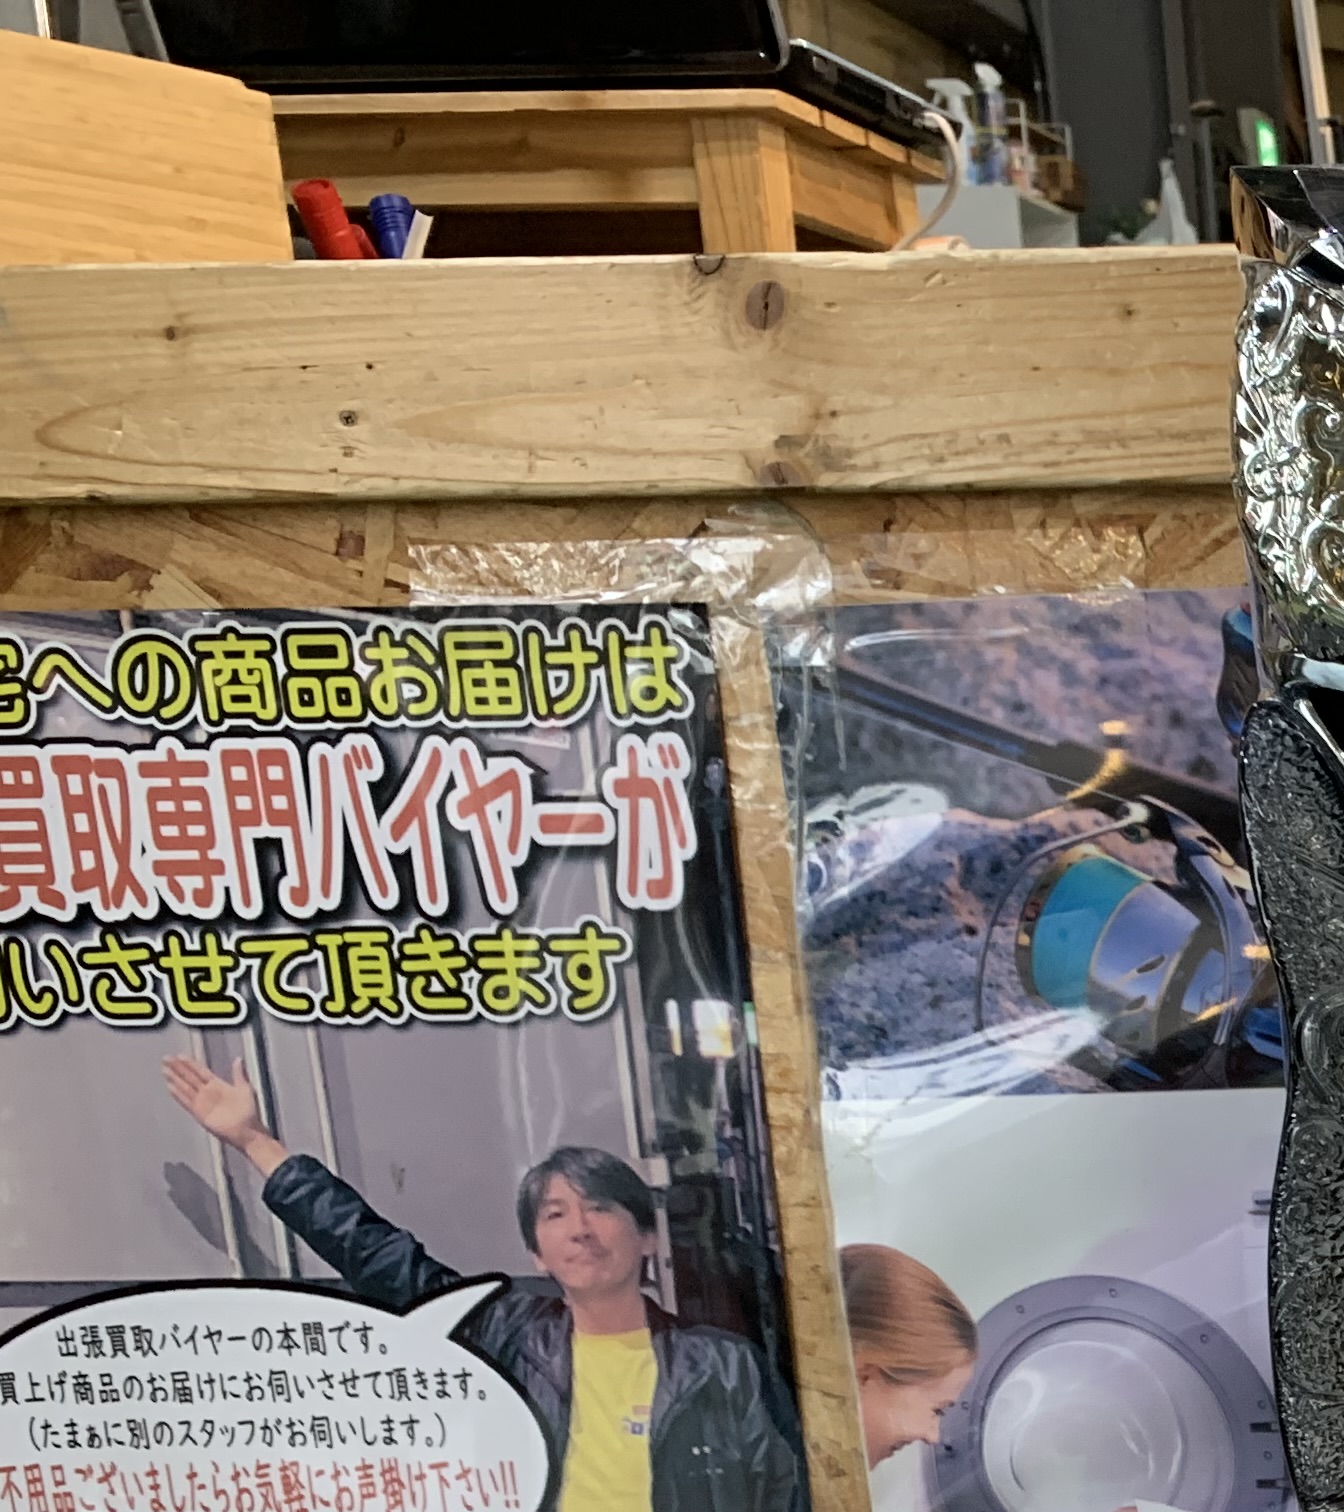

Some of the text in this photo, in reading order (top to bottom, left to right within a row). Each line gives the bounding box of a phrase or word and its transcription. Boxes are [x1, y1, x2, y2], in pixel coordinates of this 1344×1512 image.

[0, 742, 690, 914] 買取専門バイヤーが
[0, 923, 627, 1020] いさせて頂きます
[56, 1321, 388, 1359] 出張買取バイヤーの本間です。
[0, 1367, 487, 1405] 買上げ商品のお届けにお伺いさせて頂きます。
